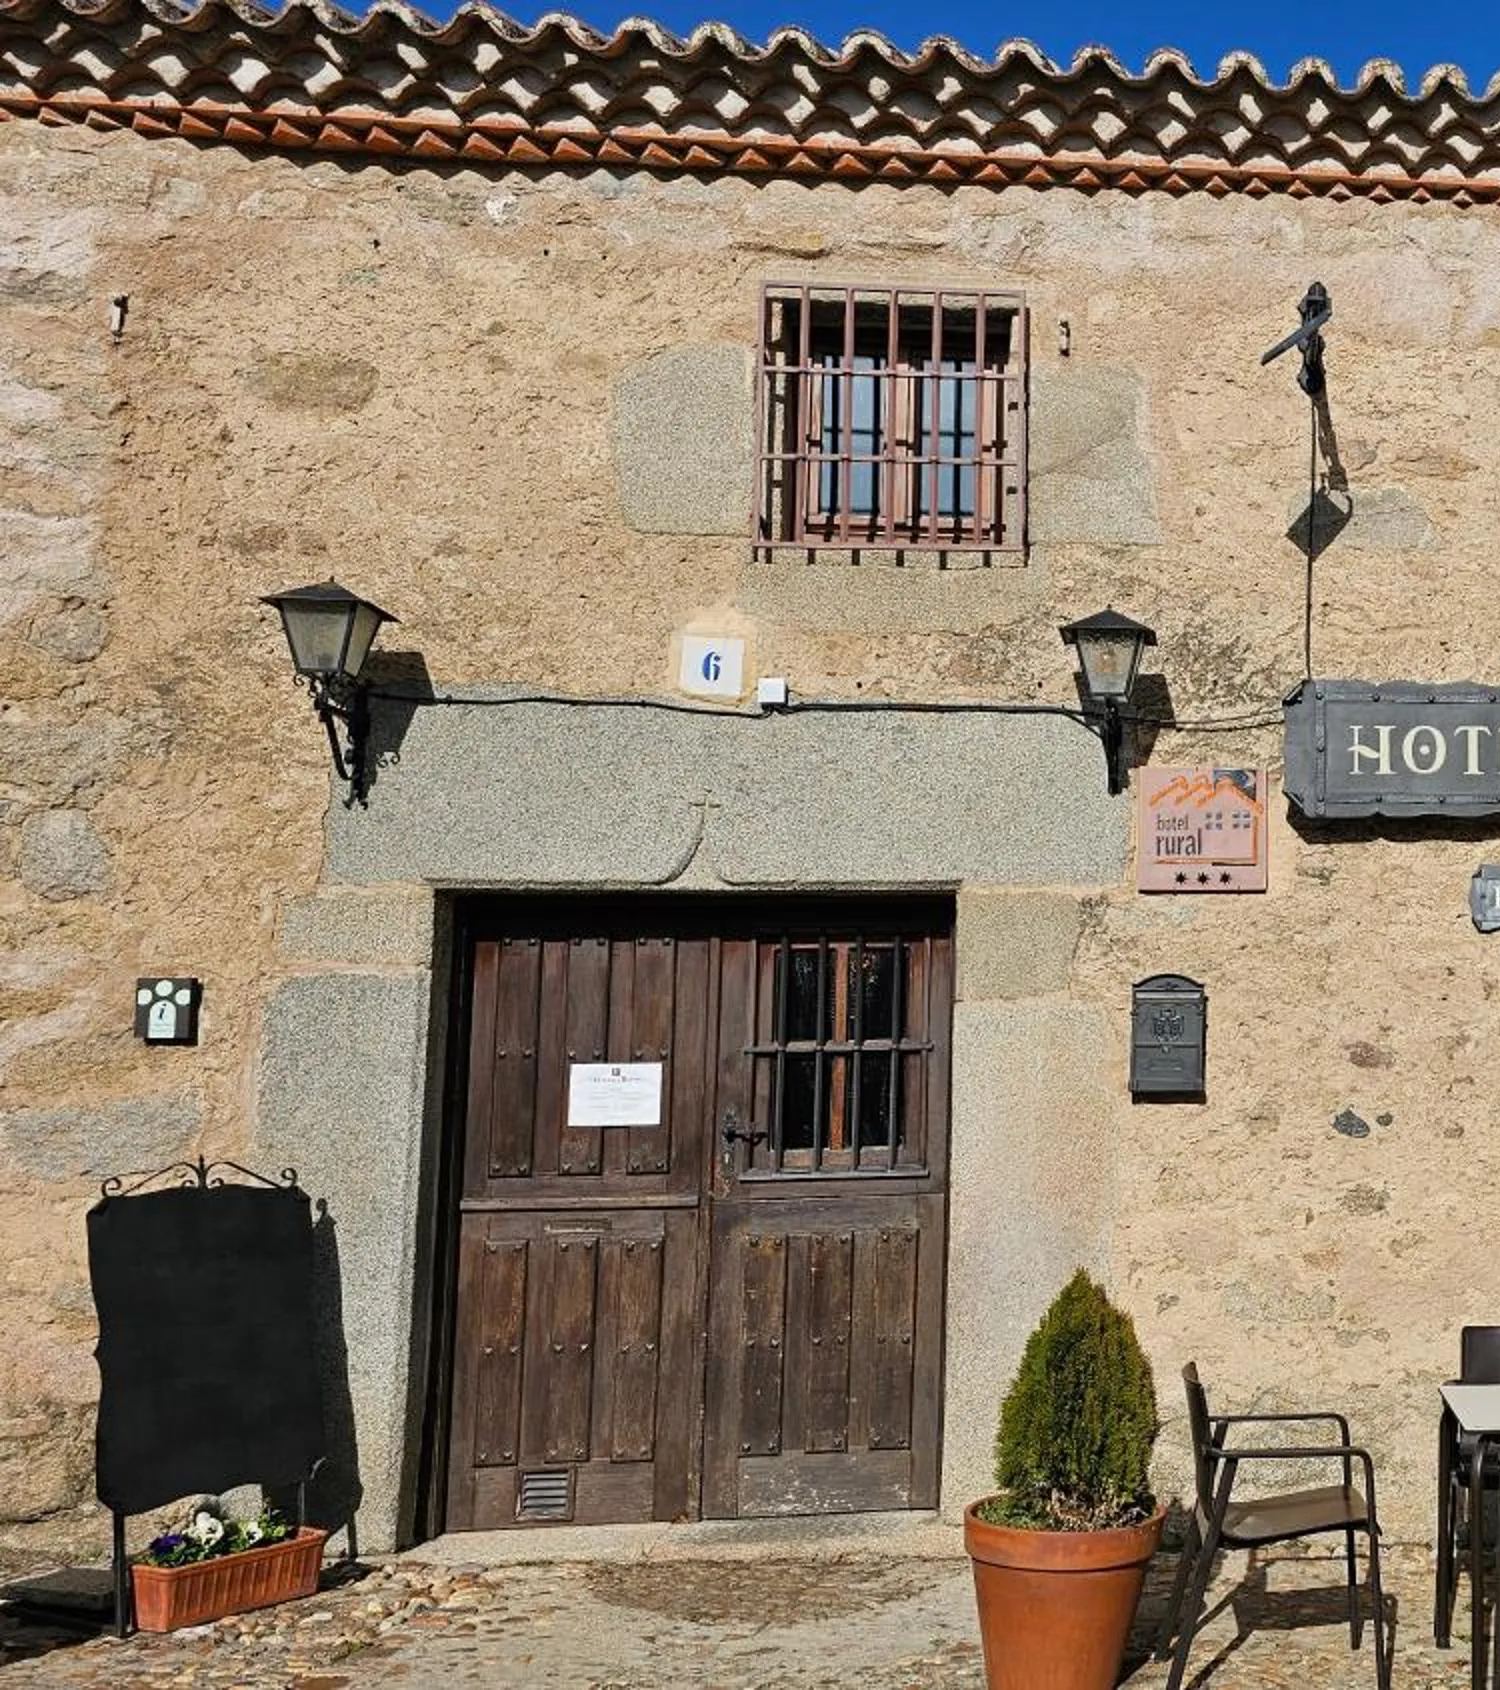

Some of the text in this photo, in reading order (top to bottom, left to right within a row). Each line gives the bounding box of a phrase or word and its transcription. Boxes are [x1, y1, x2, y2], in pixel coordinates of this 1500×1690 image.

[702, 651, 722, 681] 6
[1156, 813, 1189, 830] hotel
[1156, 828, 1202, 856] rural
